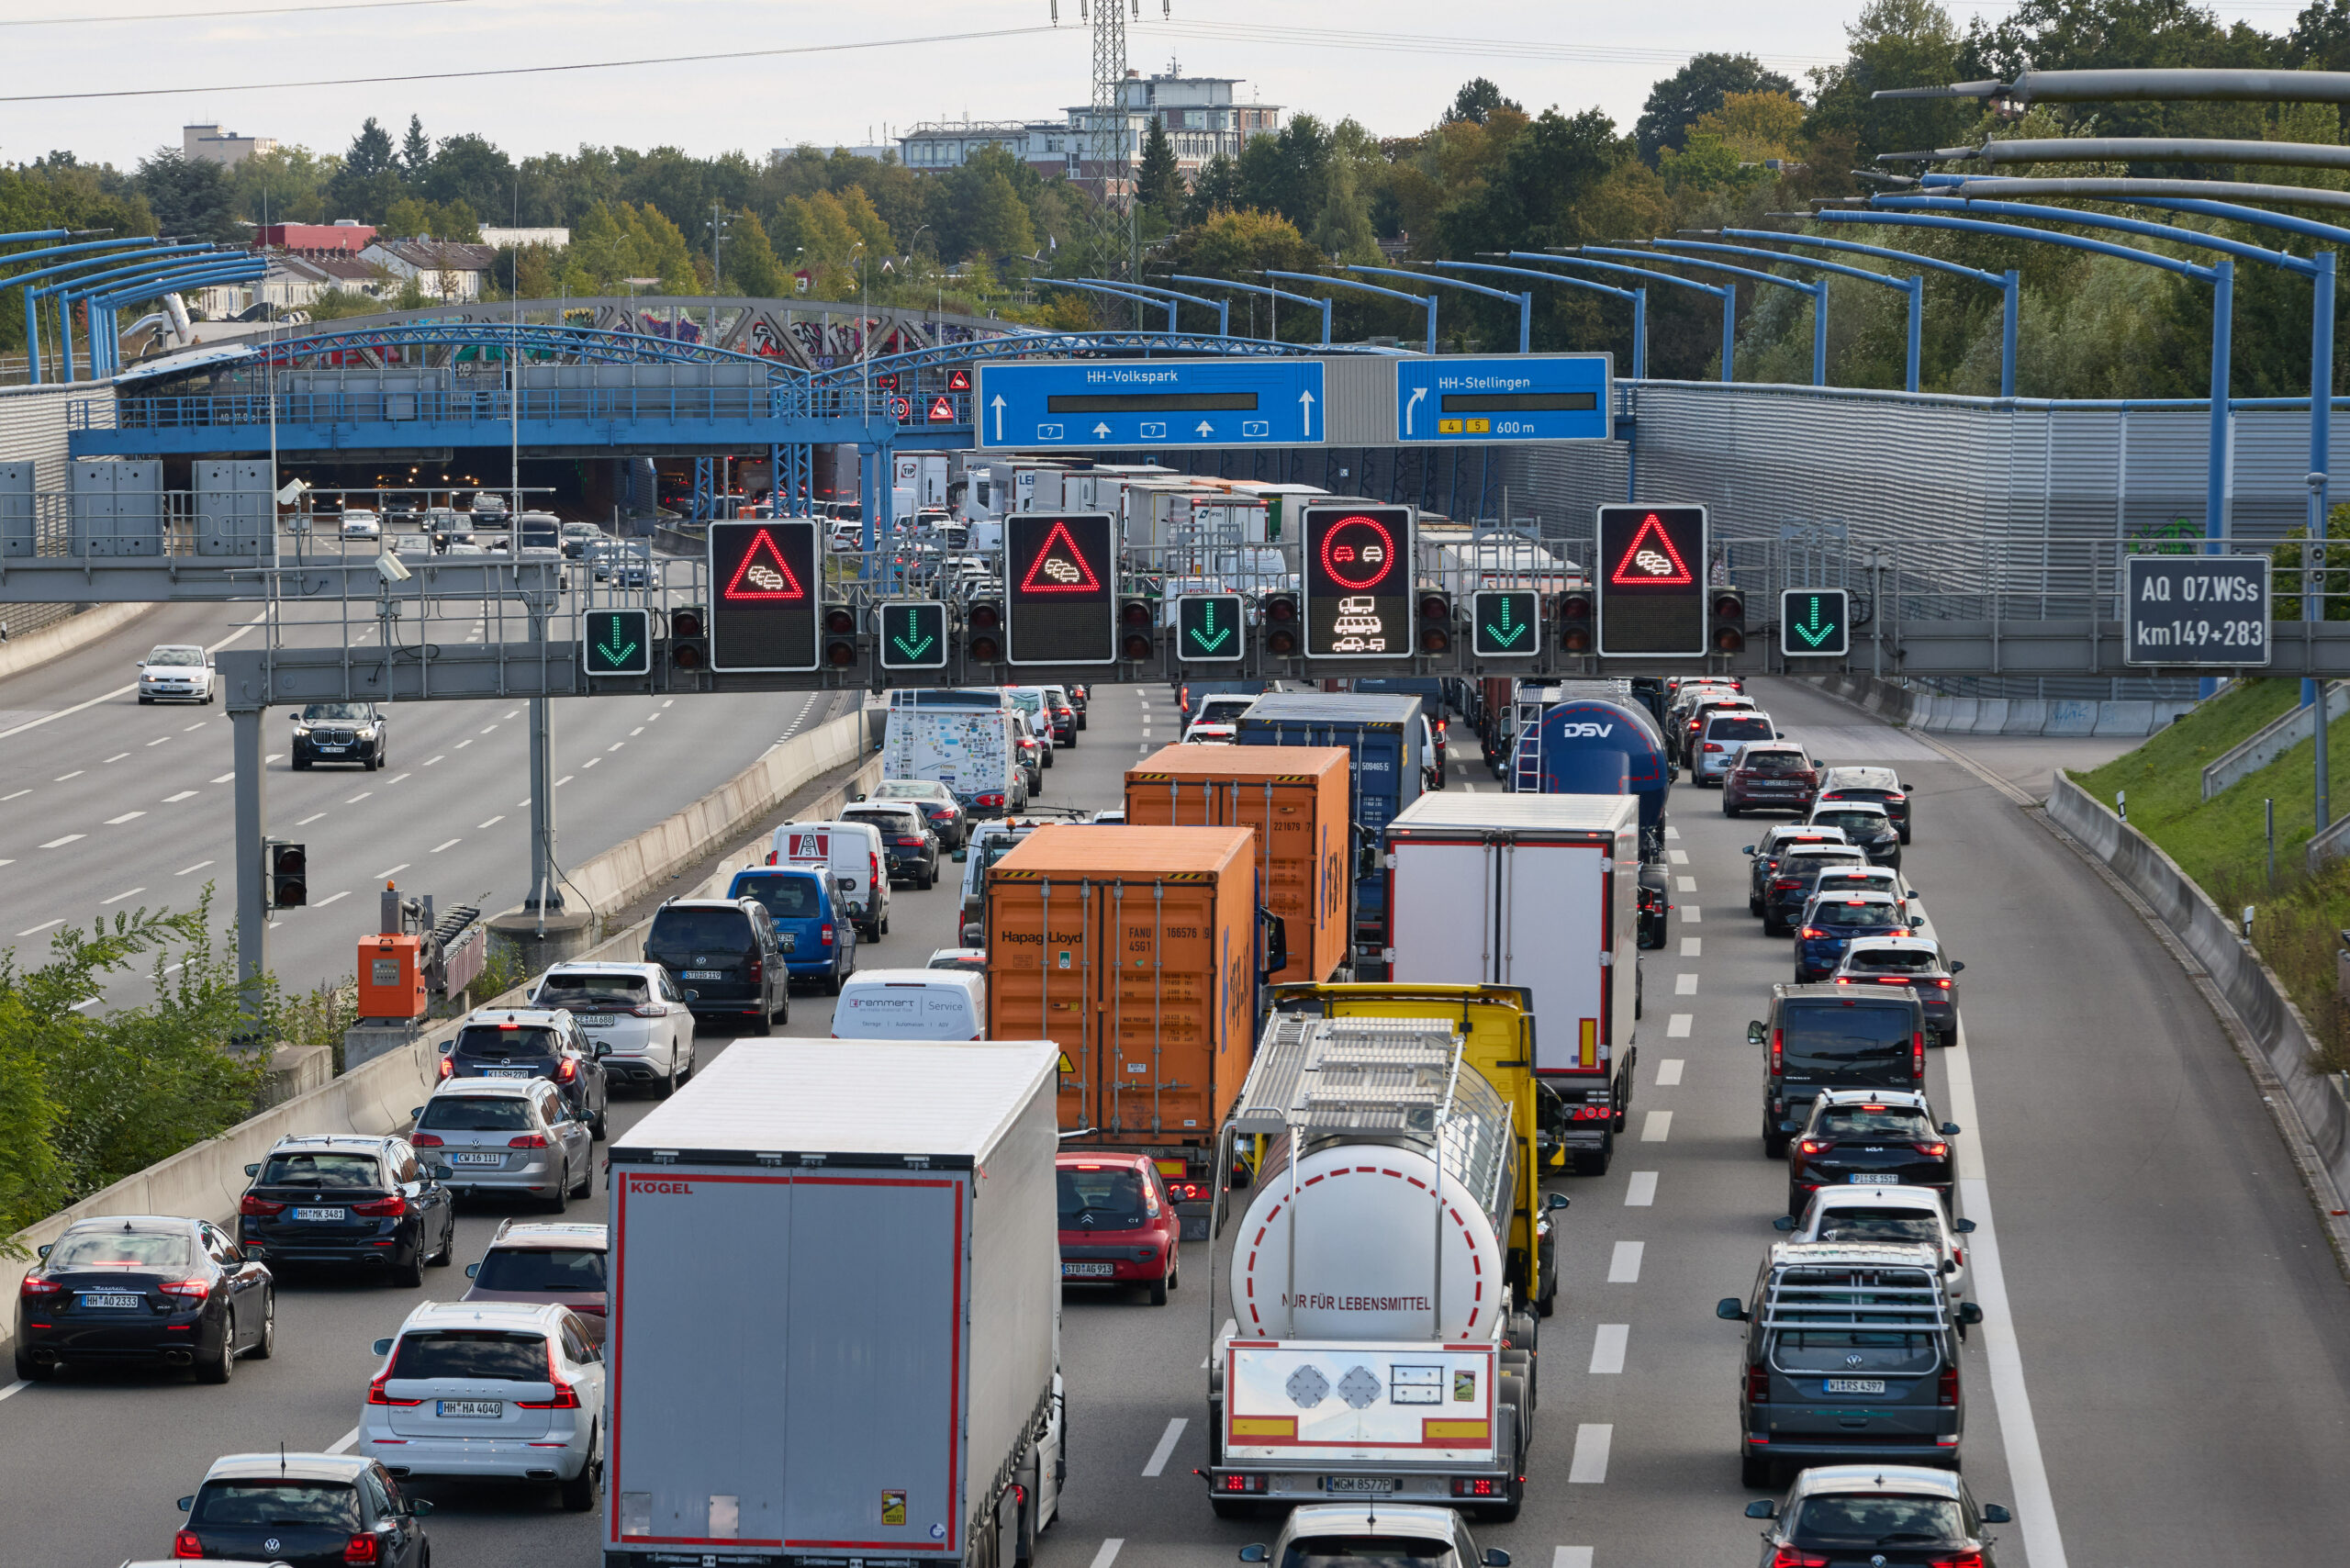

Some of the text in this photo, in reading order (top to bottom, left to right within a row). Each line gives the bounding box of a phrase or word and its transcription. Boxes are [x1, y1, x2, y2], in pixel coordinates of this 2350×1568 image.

[1087, 370, 1179, 385] HH-Volkspark
[1438, 376, 1530, 390] HH-Stellingen
[1046, 427, 1054, 436] 7
[1149, 425, 1157, 435] 7
[1251, 424, 1259, 434] 7
[1448, 421, 1535, 433] 4 5 600 m
[2141, 576, 2259, 601] AQ 07.WSs
[2137, 620, 2263, 646] km149+283
[1563, 722, 1614, 738] DSV
[1002, 931, 1083, 946] HapagLloyd
[1128, 927, 1151, 938] FANU
[1167, 927, 1197, 938] 166576
[859, 999, 963, 1011] remmert Service
[589, 1015, 599, 1024] AA
[599, 1015, 612, 1024] 688
[503, 1070, 512, 1078] SH
[513, 1070, 528, 1078] 270
[458, 1153, 497, 1162] CW 16 111
[1870, 1174, 1878, 1182] SE
[1879, 1174, 1897, 1183] 1511
[631, 1182, 694, 1194] KÖGEL
[297, 1209, 343, 1218] HH MK 3481
[1066, 1264, 1112, 1273] STD AG 913
[86, 1295, 98, 1306] HH
[116, 1295, 137, 1307] 2333
[1310, 1293, 1335, 1310] FÜR
[1338, 1296, 1431, 1311] LEBENSMITTEL
[1830, 1380, 1883, 1392] WI RS 4397
[443, 1402, 500, 1415] HH HA 4040
[1333, 1478, 1391, 1491] WGM 8577P
